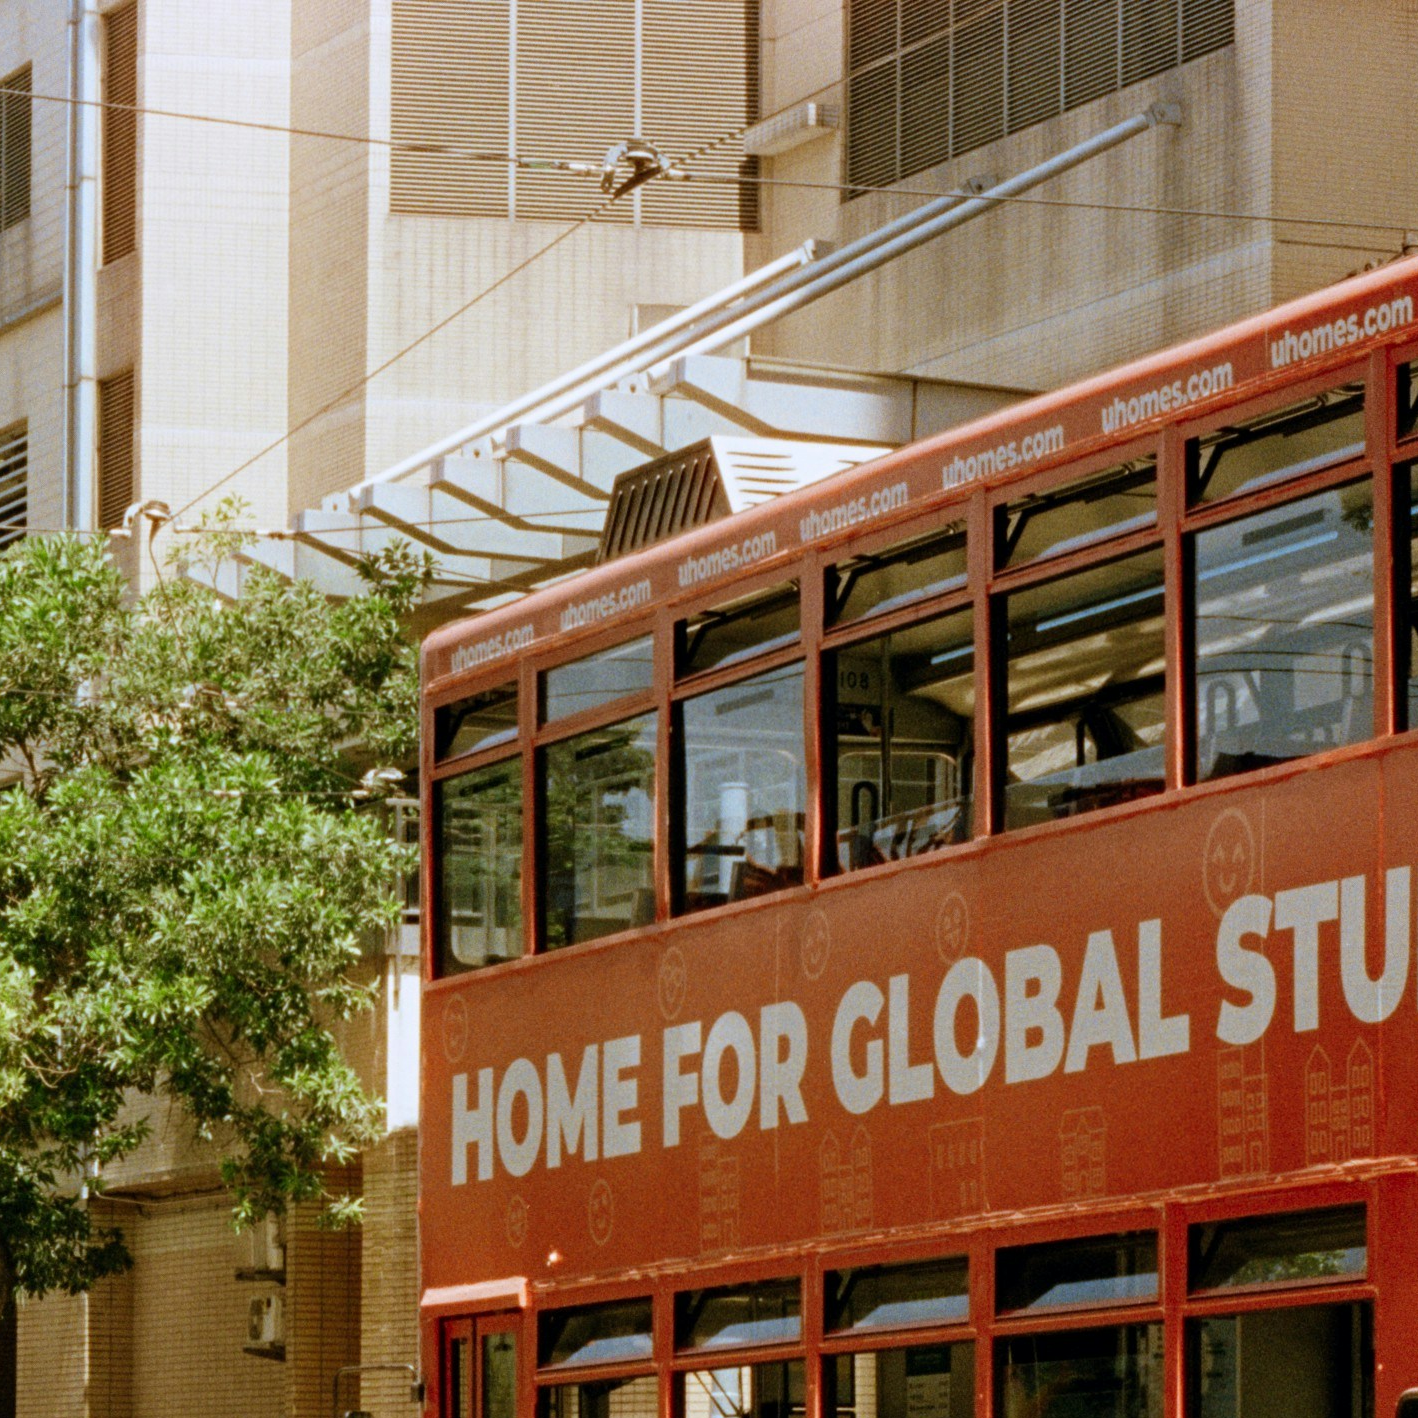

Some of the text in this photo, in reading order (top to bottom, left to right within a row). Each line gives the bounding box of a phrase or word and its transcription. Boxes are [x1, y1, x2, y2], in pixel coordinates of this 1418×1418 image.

[1271, 294, 1413, 368] uhomes.com
[1102, 361, 1233, 435] uhomes.com
[942, 423, 1064, 490] uhomes.com
[800, 480, 909, 542] uhomes.com
[678, 529, 776, 586] uhomes.com
[560, 577, 651, 632] uhomes.com
[450, 622, 534, 674] uhomes.com
[451, 1034, 641, 1186] HOME
[662, 1000, 809, 1147] FOR
[831, 918, 1190, 1114] GLOBAL
